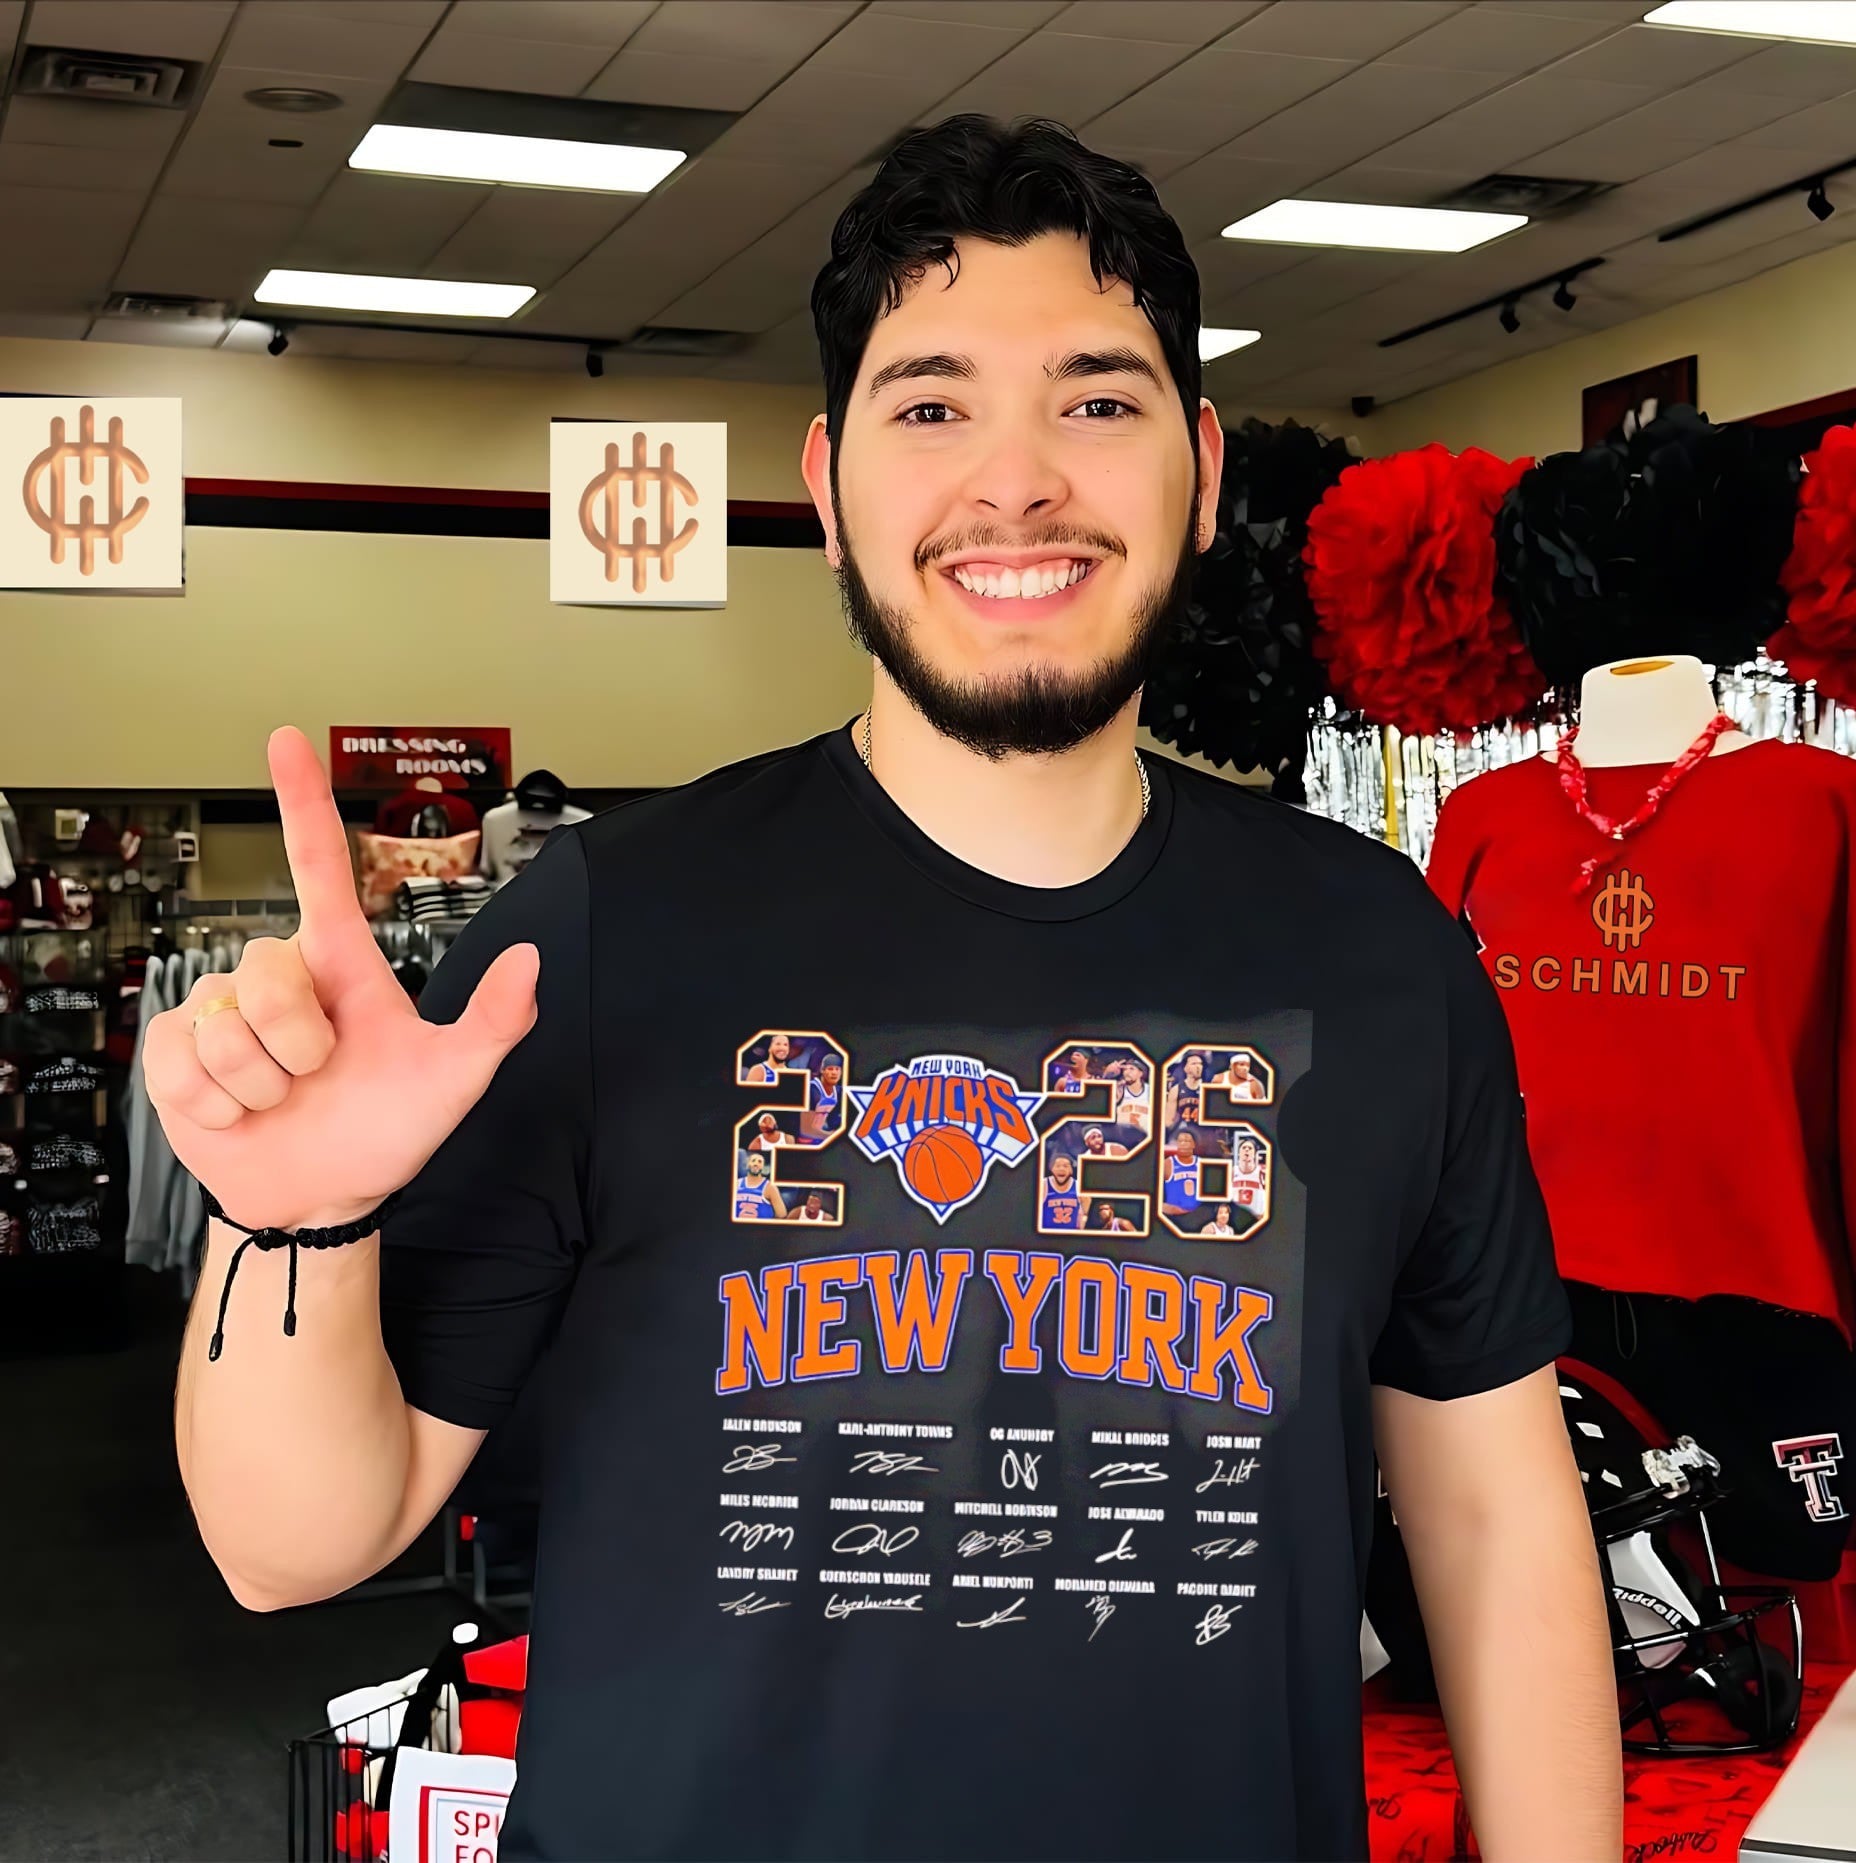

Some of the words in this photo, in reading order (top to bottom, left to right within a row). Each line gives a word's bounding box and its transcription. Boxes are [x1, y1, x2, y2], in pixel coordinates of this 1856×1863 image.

[341, 737, 467, 753] DRESSING
[395, 758, 488, 775] ROOMS
[1493, 953, 1747, 1001] SCHMIDT
[911, 1059, 942, 1077] NEW
[945, 1060, 983, 1079] YORK
[855, 1073, 1034, 1160] KNICKS
[716, 1248, 974, 1395] NEW
[983, 1248, 1274, 1416] YORK
